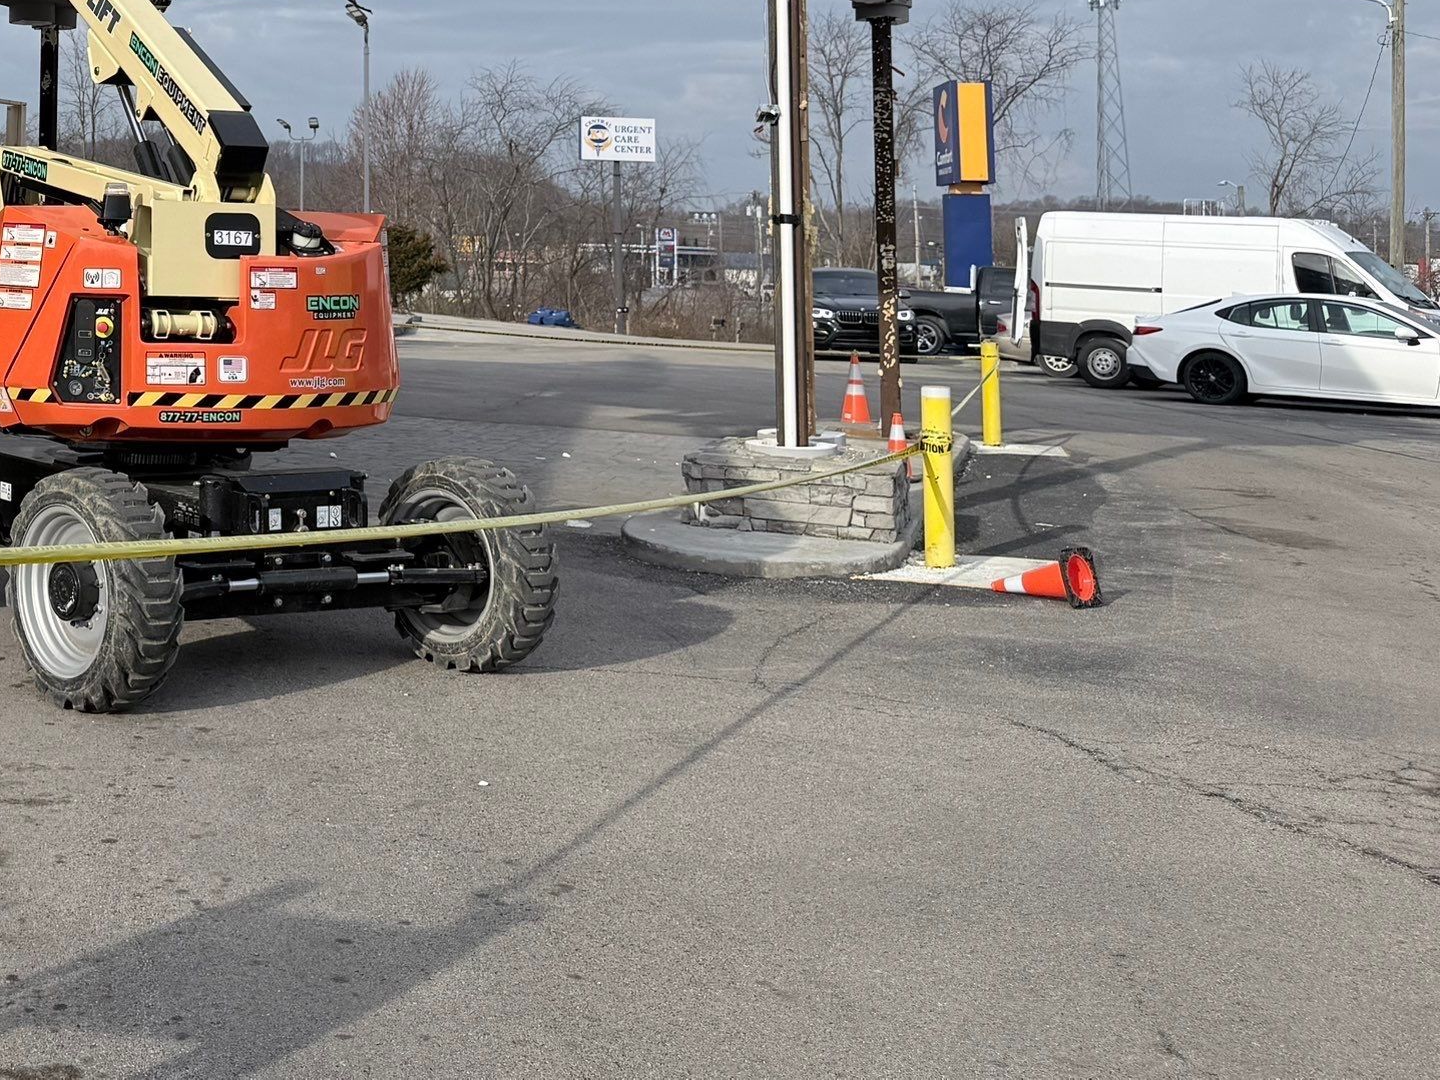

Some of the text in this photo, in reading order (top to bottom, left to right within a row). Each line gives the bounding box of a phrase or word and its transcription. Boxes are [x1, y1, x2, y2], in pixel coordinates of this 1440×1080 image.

[131, 35, 207, 135] ENCON EQUIPMENT
[614, 125, 652, 134] URGENT
[614, 135, 640, 143] CARE
[614, 145, 652, 154] CENTER
[2, 151, 47, 180] 877-77-ENCON
[215, 231, 251, 245] 3167
[307, 295, 359, 311] ENCON
[313, 311, 355, 319] EQUIPMENT
[279, 328, 367, 373] JLG
[289, 376, 345, 388] www.jlg.com
[160, 411, 240, 422] 877-77-ENCON
